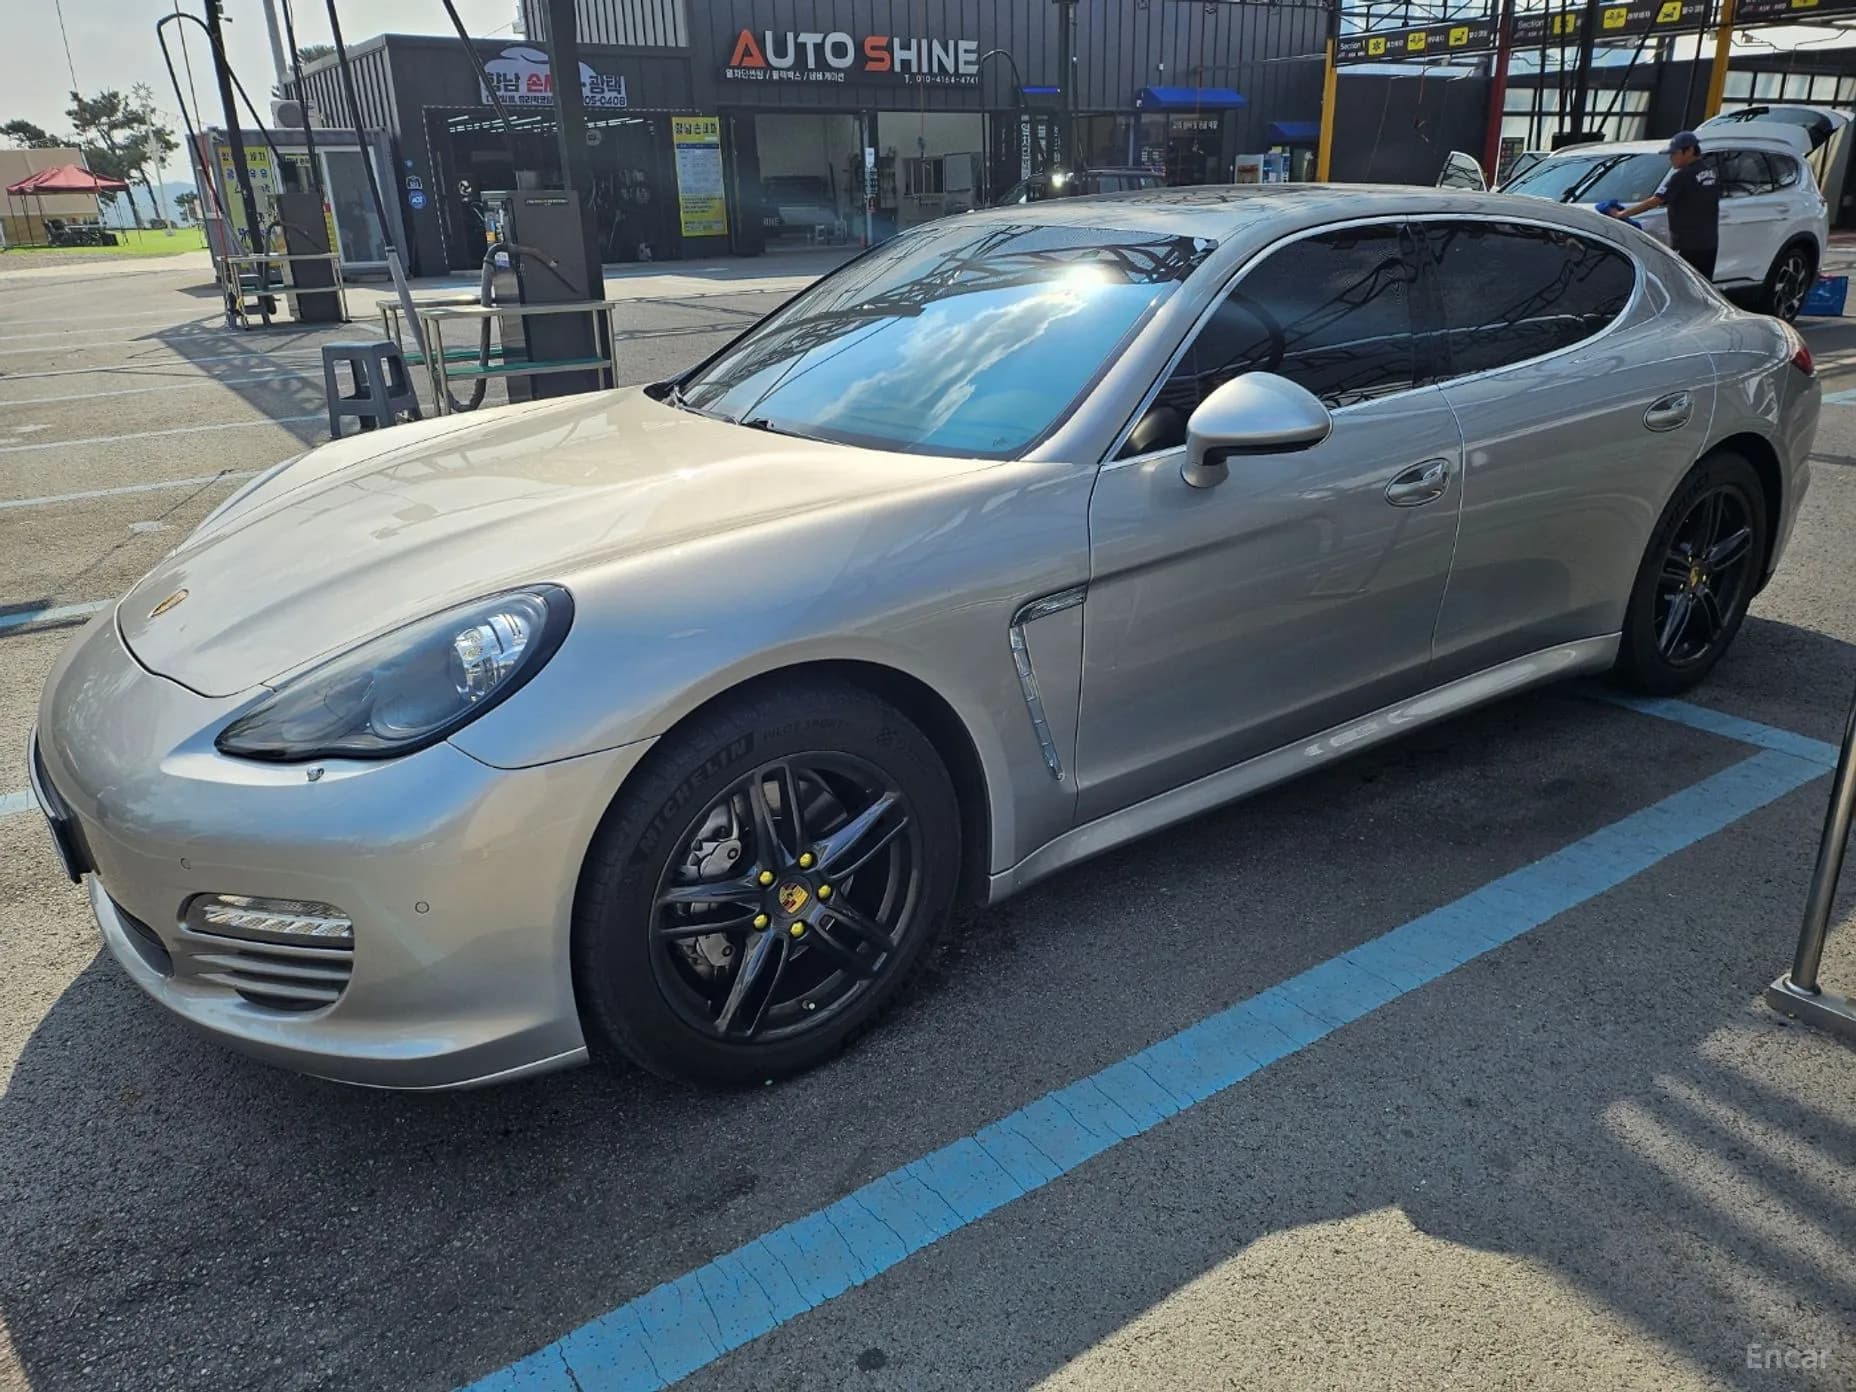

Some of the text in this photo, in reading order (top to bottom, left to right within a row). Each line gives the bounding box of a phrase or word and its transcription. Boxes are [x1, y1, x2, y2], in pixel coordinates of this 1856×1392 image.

[730, 28, 979, 74] AUTO SHINE
[1340, 41, 1361, 50] Section
[589, 75, 622, 94] 광택
